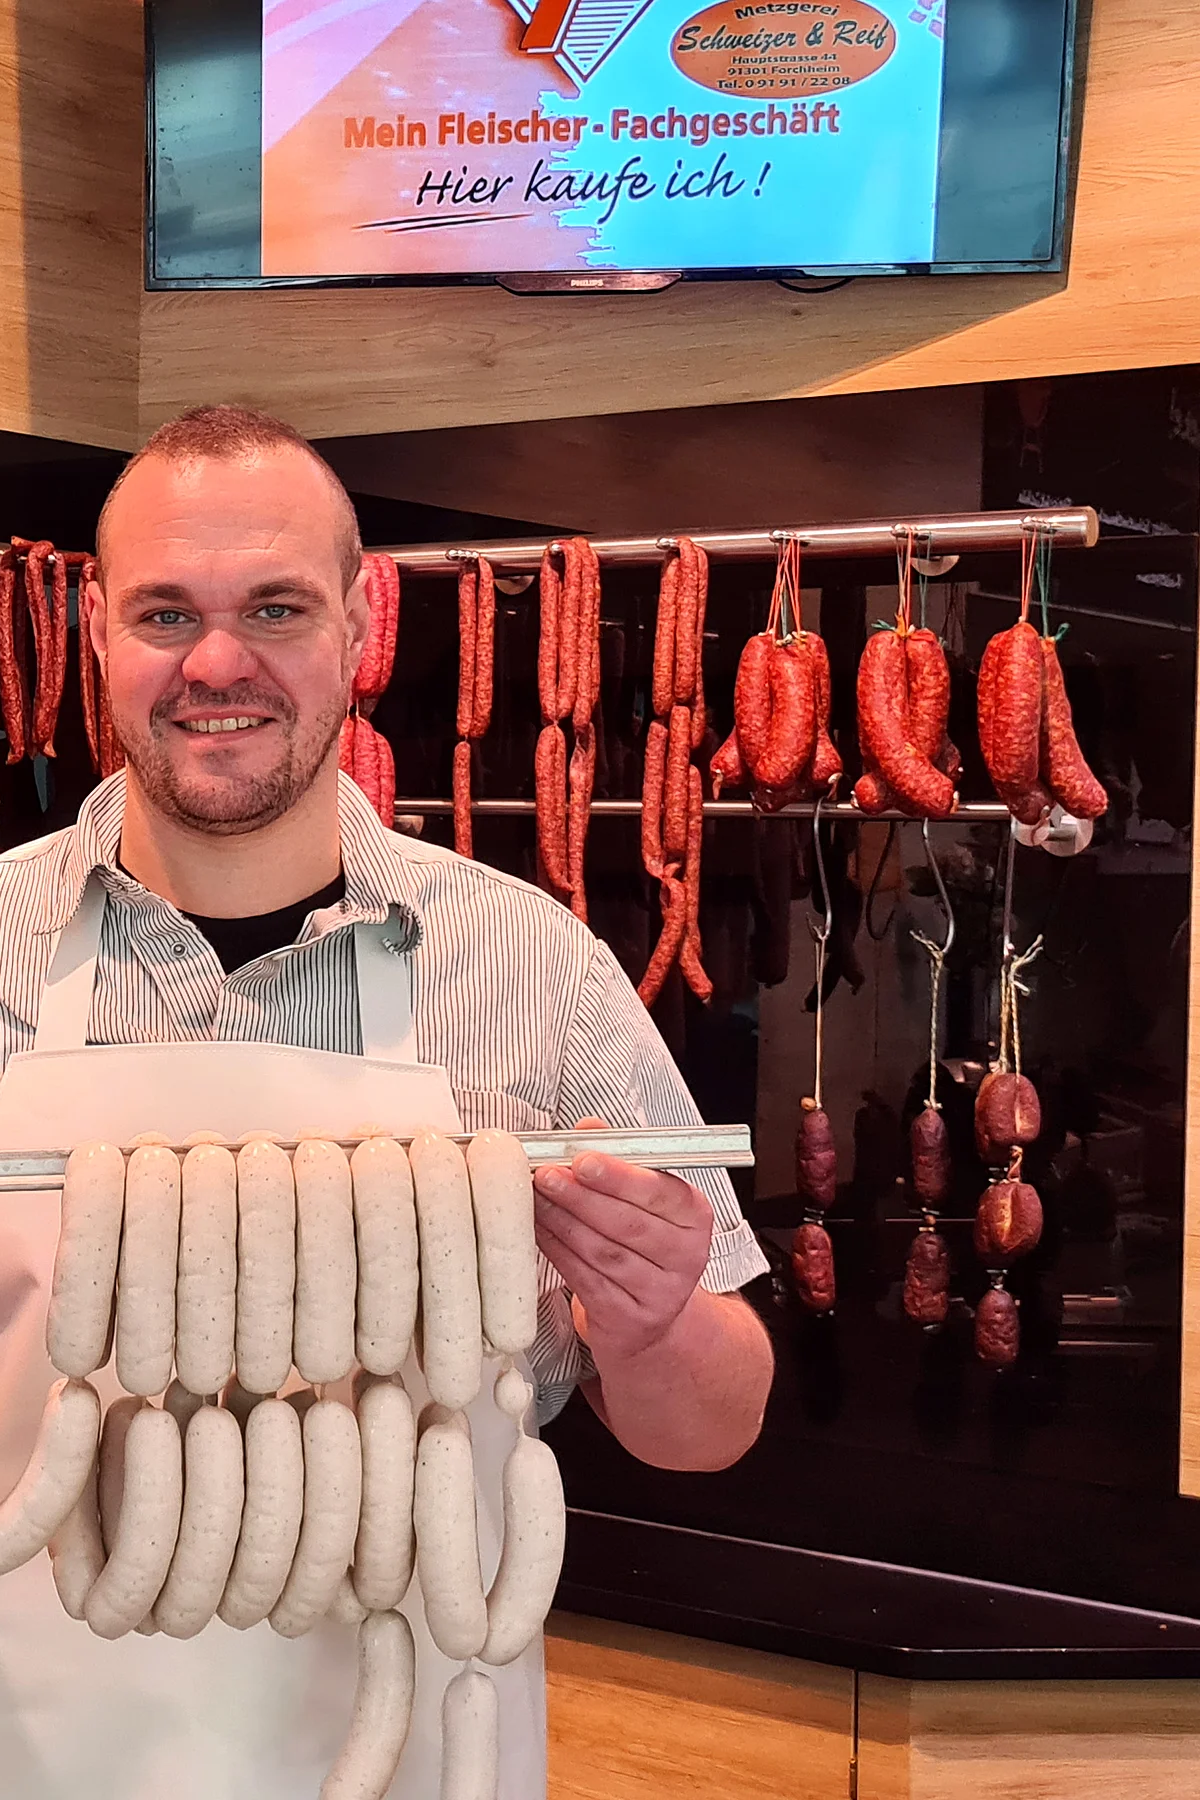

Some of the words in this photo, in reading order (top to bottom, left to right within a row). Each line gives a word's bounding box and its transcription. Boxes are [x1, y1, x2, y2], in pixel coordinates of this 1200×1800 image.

[735, 2, 840, 19] Metzgerei
[677, 25, 797, 53] Schweizer
[807, 21, 825, 46] &
[833, 19, 890, 49] Reif
[732, 55, 818, 65] Hauptstrasse
[728, 67, 767, 76] 91301
[771, 65, 840, 74] Forchheim
[718, 80, 742, 89] Tel.
[344, 116, 426, 148] Mein
[416, 164, 513, 206] Hier
[525, 156, 655, 224] kaufe
[571, 279, 604, 287] PHILIPS
